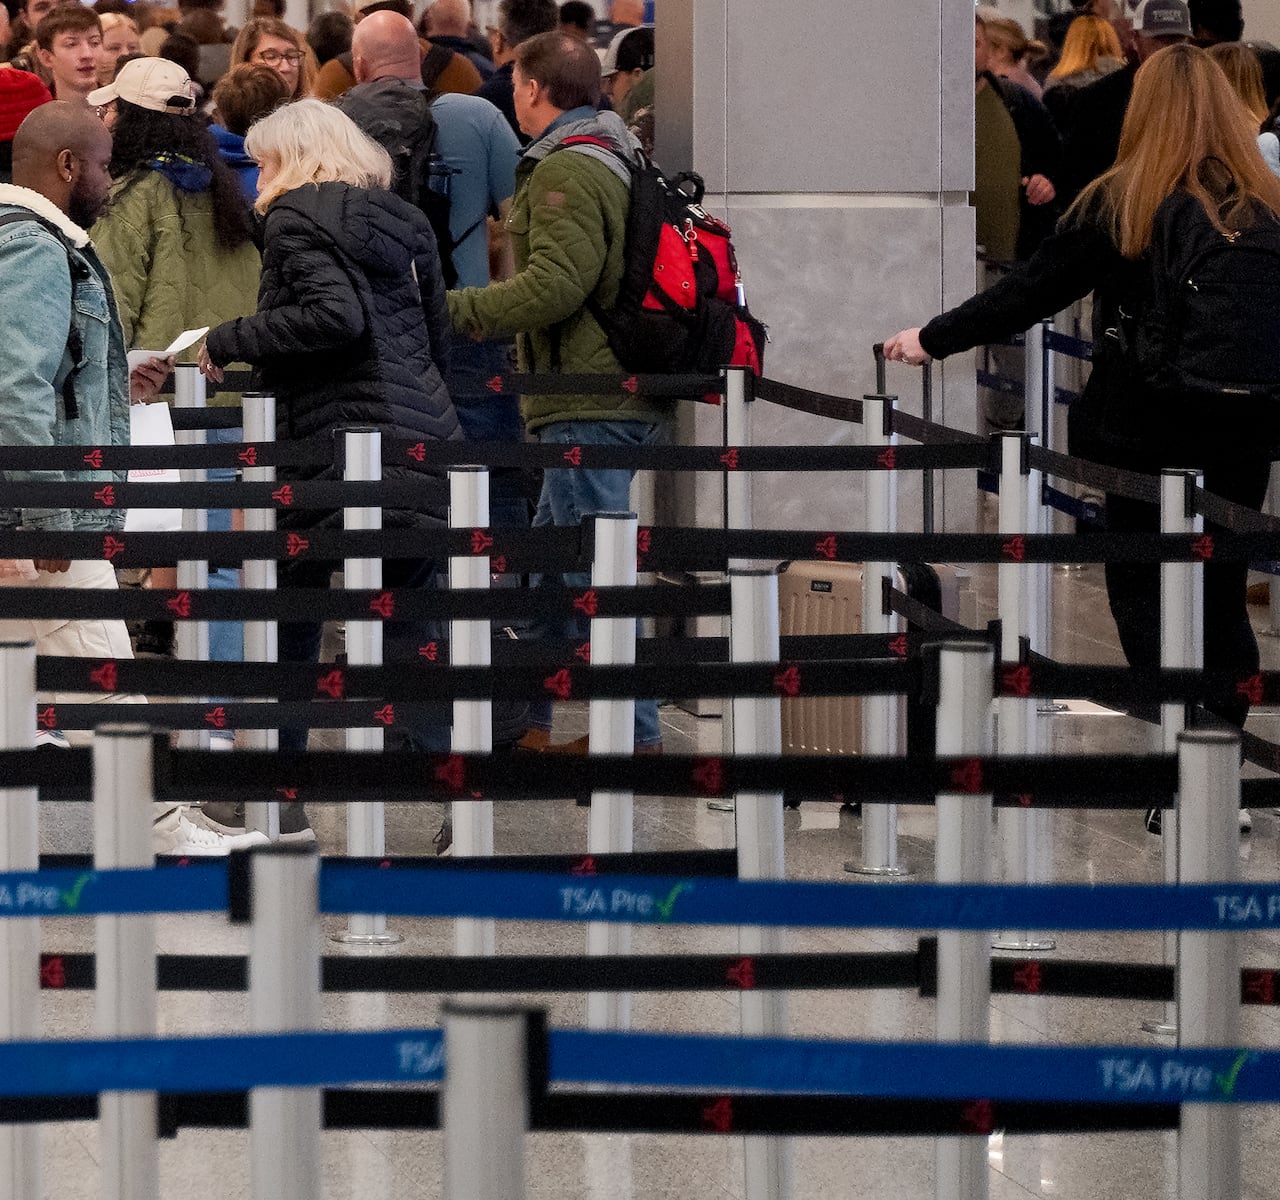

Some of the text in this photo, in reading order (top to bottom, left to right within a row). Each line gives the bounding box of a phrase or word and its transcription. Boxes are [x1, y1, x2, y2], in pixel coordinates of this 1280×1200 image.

[17, 883, 60, 909] Pre
[559, 887, 653, 915] TSA Pre
[1215, 896, 1264, 922] TSA
[1099, 1059, 1212, 1092] TSA Pre
